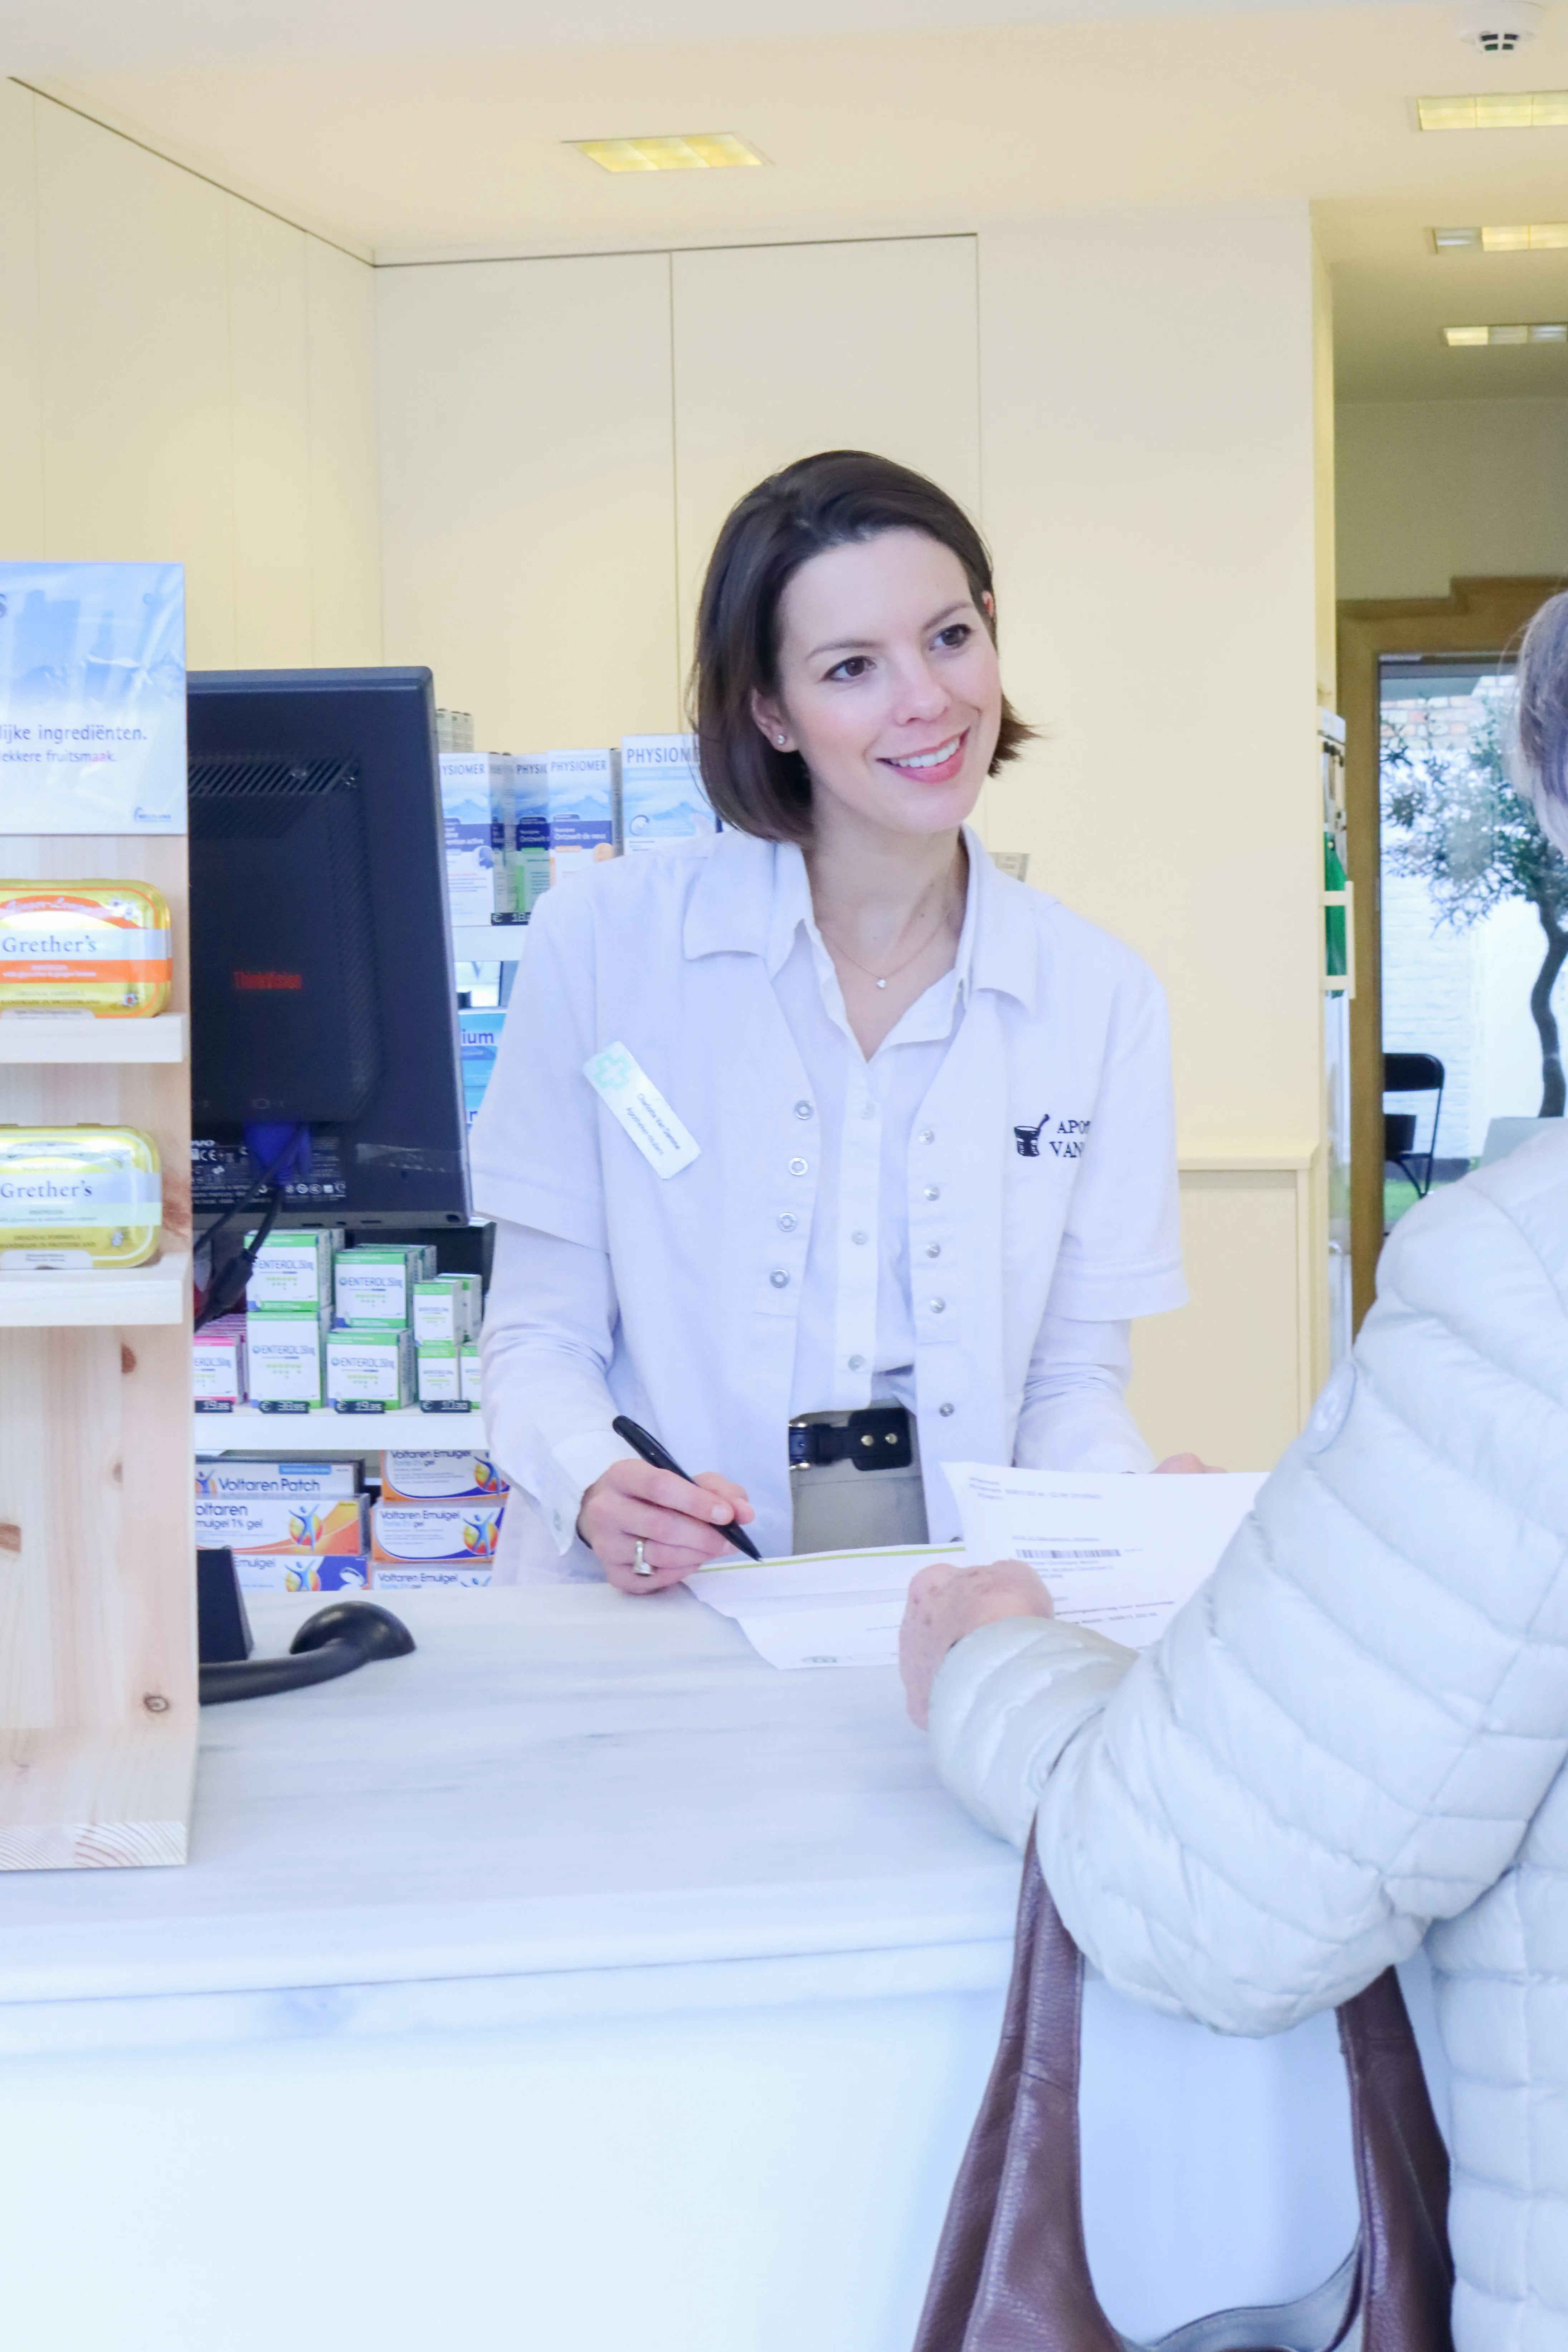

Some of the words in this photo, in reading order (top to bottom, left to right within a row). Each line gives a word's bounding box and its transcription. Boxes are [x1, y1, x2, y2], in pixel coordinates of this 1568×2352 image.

[38, 724, 147, 744] ingrediënten.
[1, 750, 42, 762] ekkere
[442, 764, 486, 775] YSIOMER
[550, 760, 606, 771] PHYSIOMER
[3, 935, 97, 953] Grether's
[1, 1180, 92, 1198] Grether's
[218, 1477, 278, 1491] Voltaren
[281, 1478, 320, 1491] Patch
[380, 1510, 420, 1519] Voltaren
[423, 1510, 461, 1521] Emulgel
[378, 1573, 419, 1582] Voltaren
[420, 1573, 458, 1584] Emulgel
